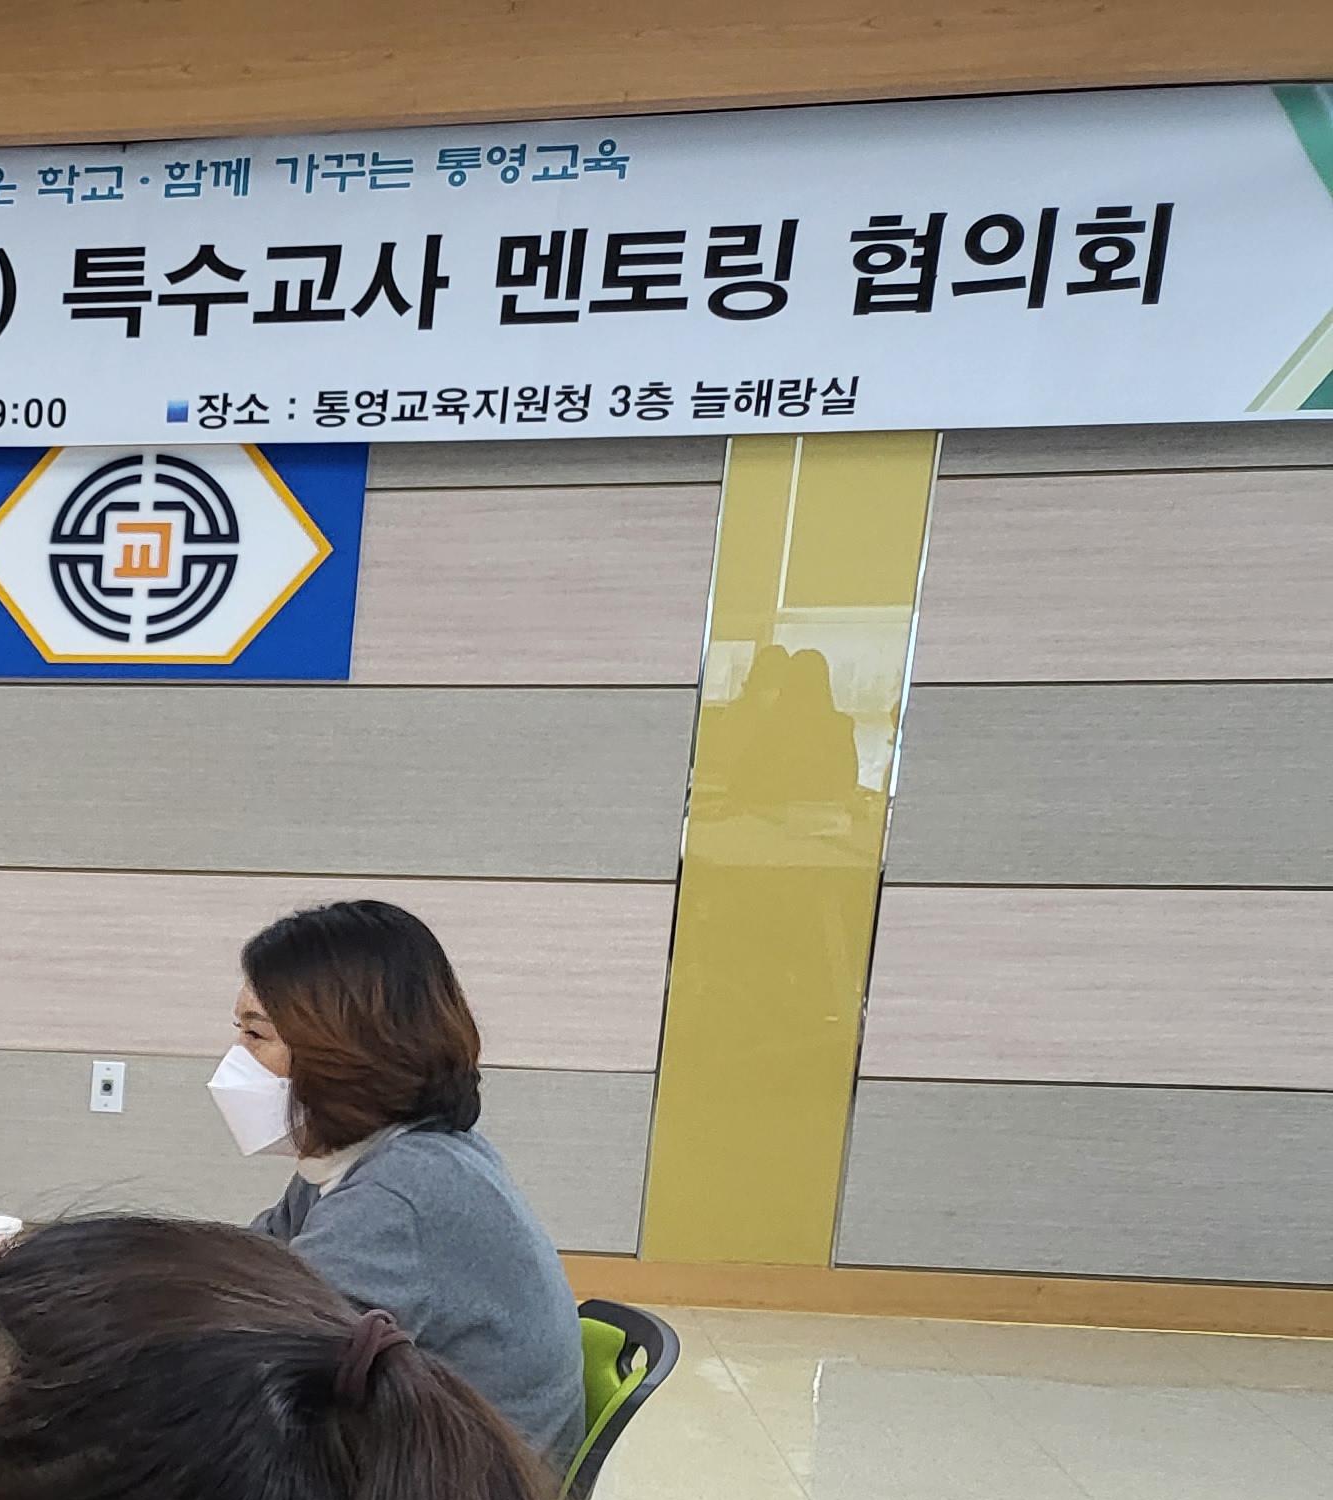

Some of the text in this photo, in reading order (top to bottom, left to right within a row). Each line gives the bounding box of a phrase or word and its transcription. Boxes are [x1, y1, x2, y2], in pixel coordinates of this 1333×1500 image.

[275, 152, 414, 195] 가꾸는
[437, 138, 632, 188] 통영교육
[61, 233, 450, 340] 특수교사
[494, 217, 800, 327] 멘토링
[848, 201, 1176, 317] 협의회
[196, 391, 271, 430] 장소
[311, 383, 593, 430] 통영교육지원청
[608, 381, 675, 422] 3층
[689, 374, 861, 420] 늘해랑실
